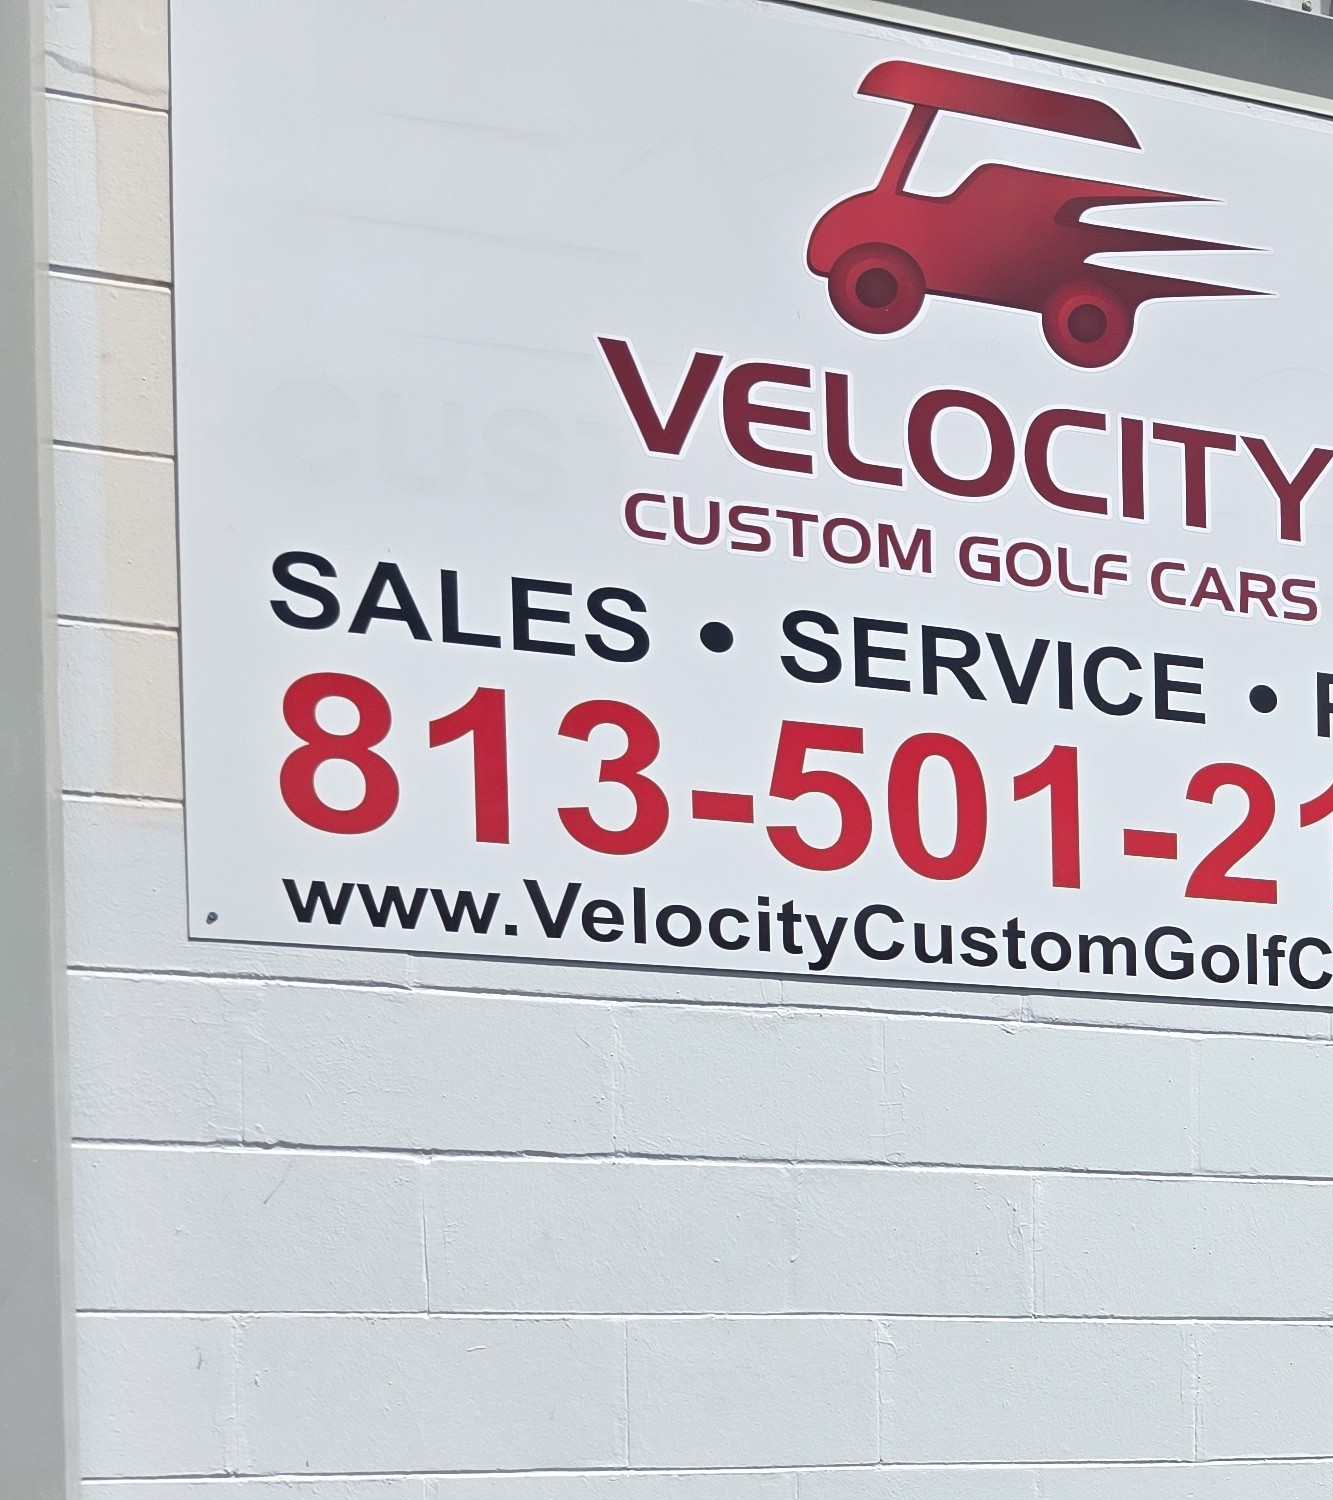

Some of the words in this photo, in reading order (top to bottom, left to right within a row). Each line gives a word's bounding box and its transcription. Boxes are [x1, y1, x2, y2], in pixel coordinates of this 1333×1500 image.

[624, 492, 932, 574] CUSTOM
[959, 536, 1128, 596] GOLF
[1150, 561, 1318, 622] CARS
[269, 550, 650, 663] SALES
[780, 609, 1206, 725] SERVICE
